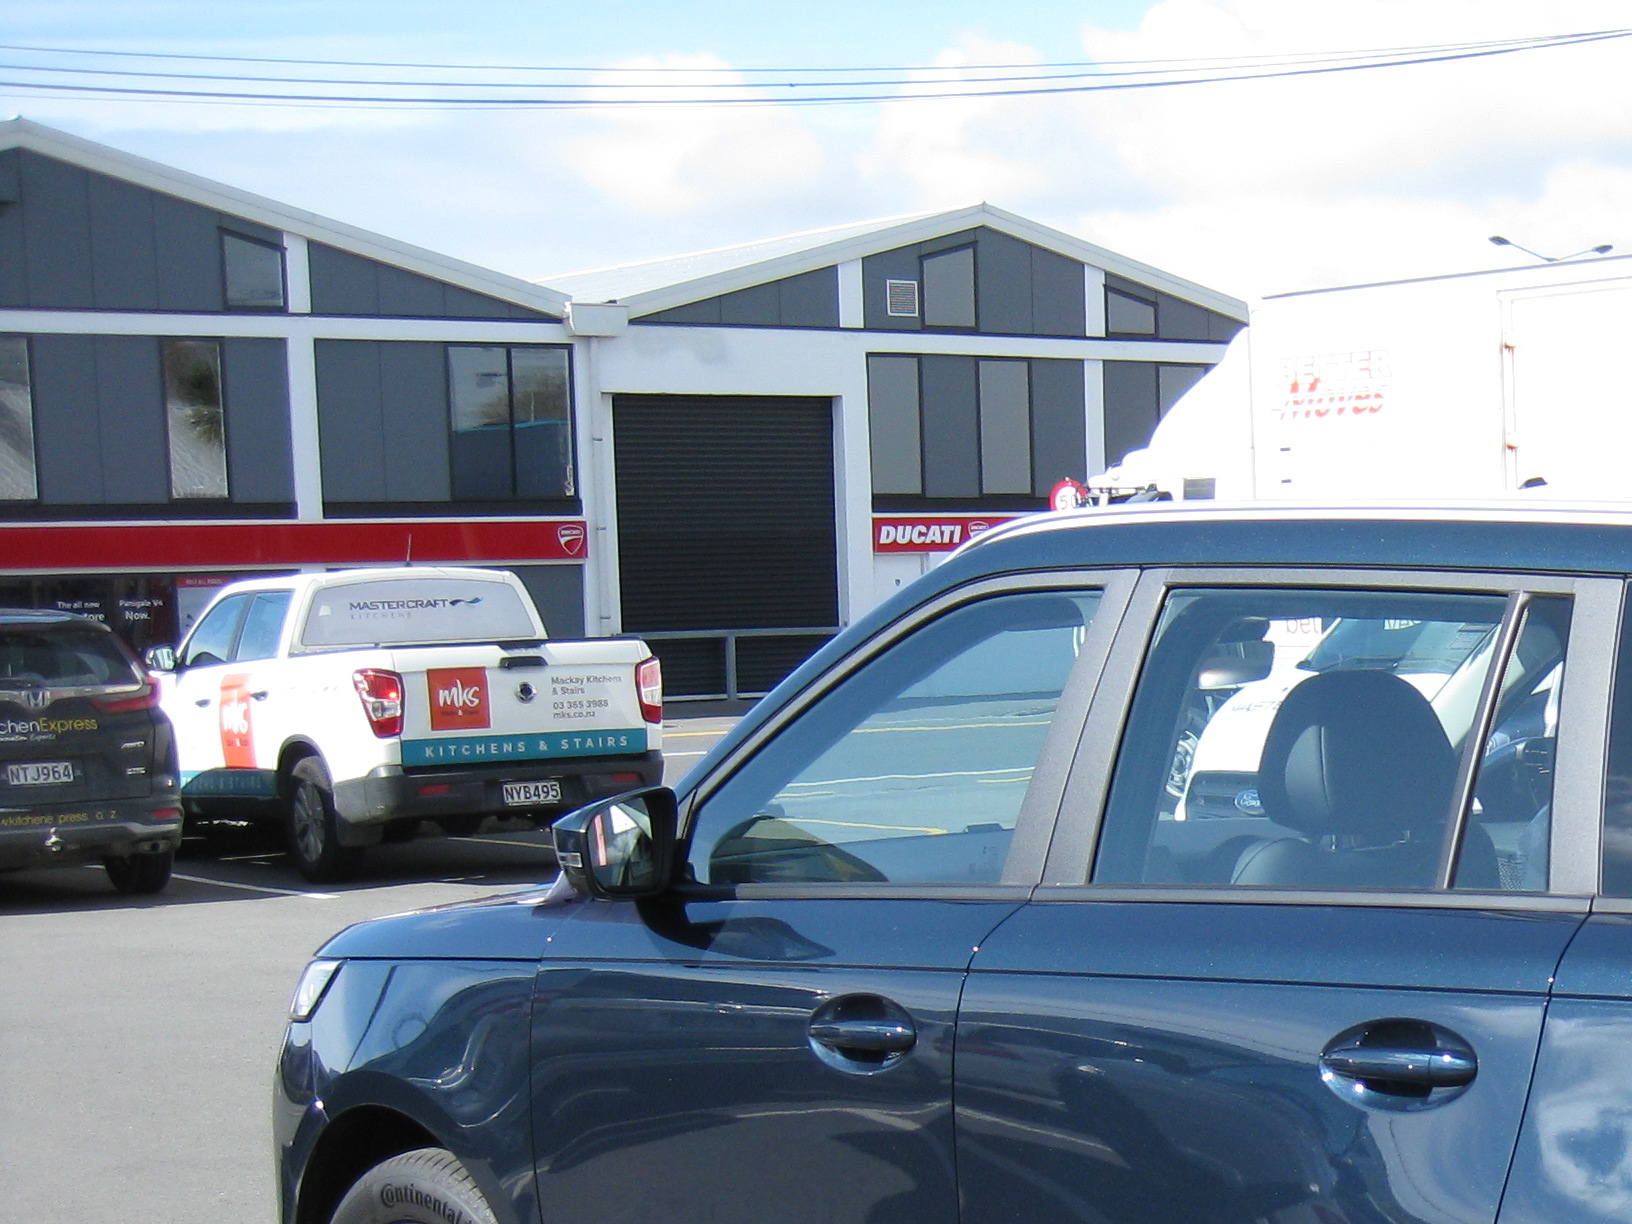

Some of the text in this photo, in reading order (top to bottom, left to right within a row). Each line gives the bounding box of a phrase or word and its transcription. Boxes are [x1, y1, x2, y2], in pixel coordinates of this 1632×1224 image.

[879, 525, 962, 544] DUCATI
[349, 598, 449, 611] MASTERCRAFT
[438, 679, 481, 708] mks
[425, 735, 629, 758] KITCHENS & STAIRS
[9, 764, 72, 783] NTJ964
[504, 786, 560, 801] NYB495
